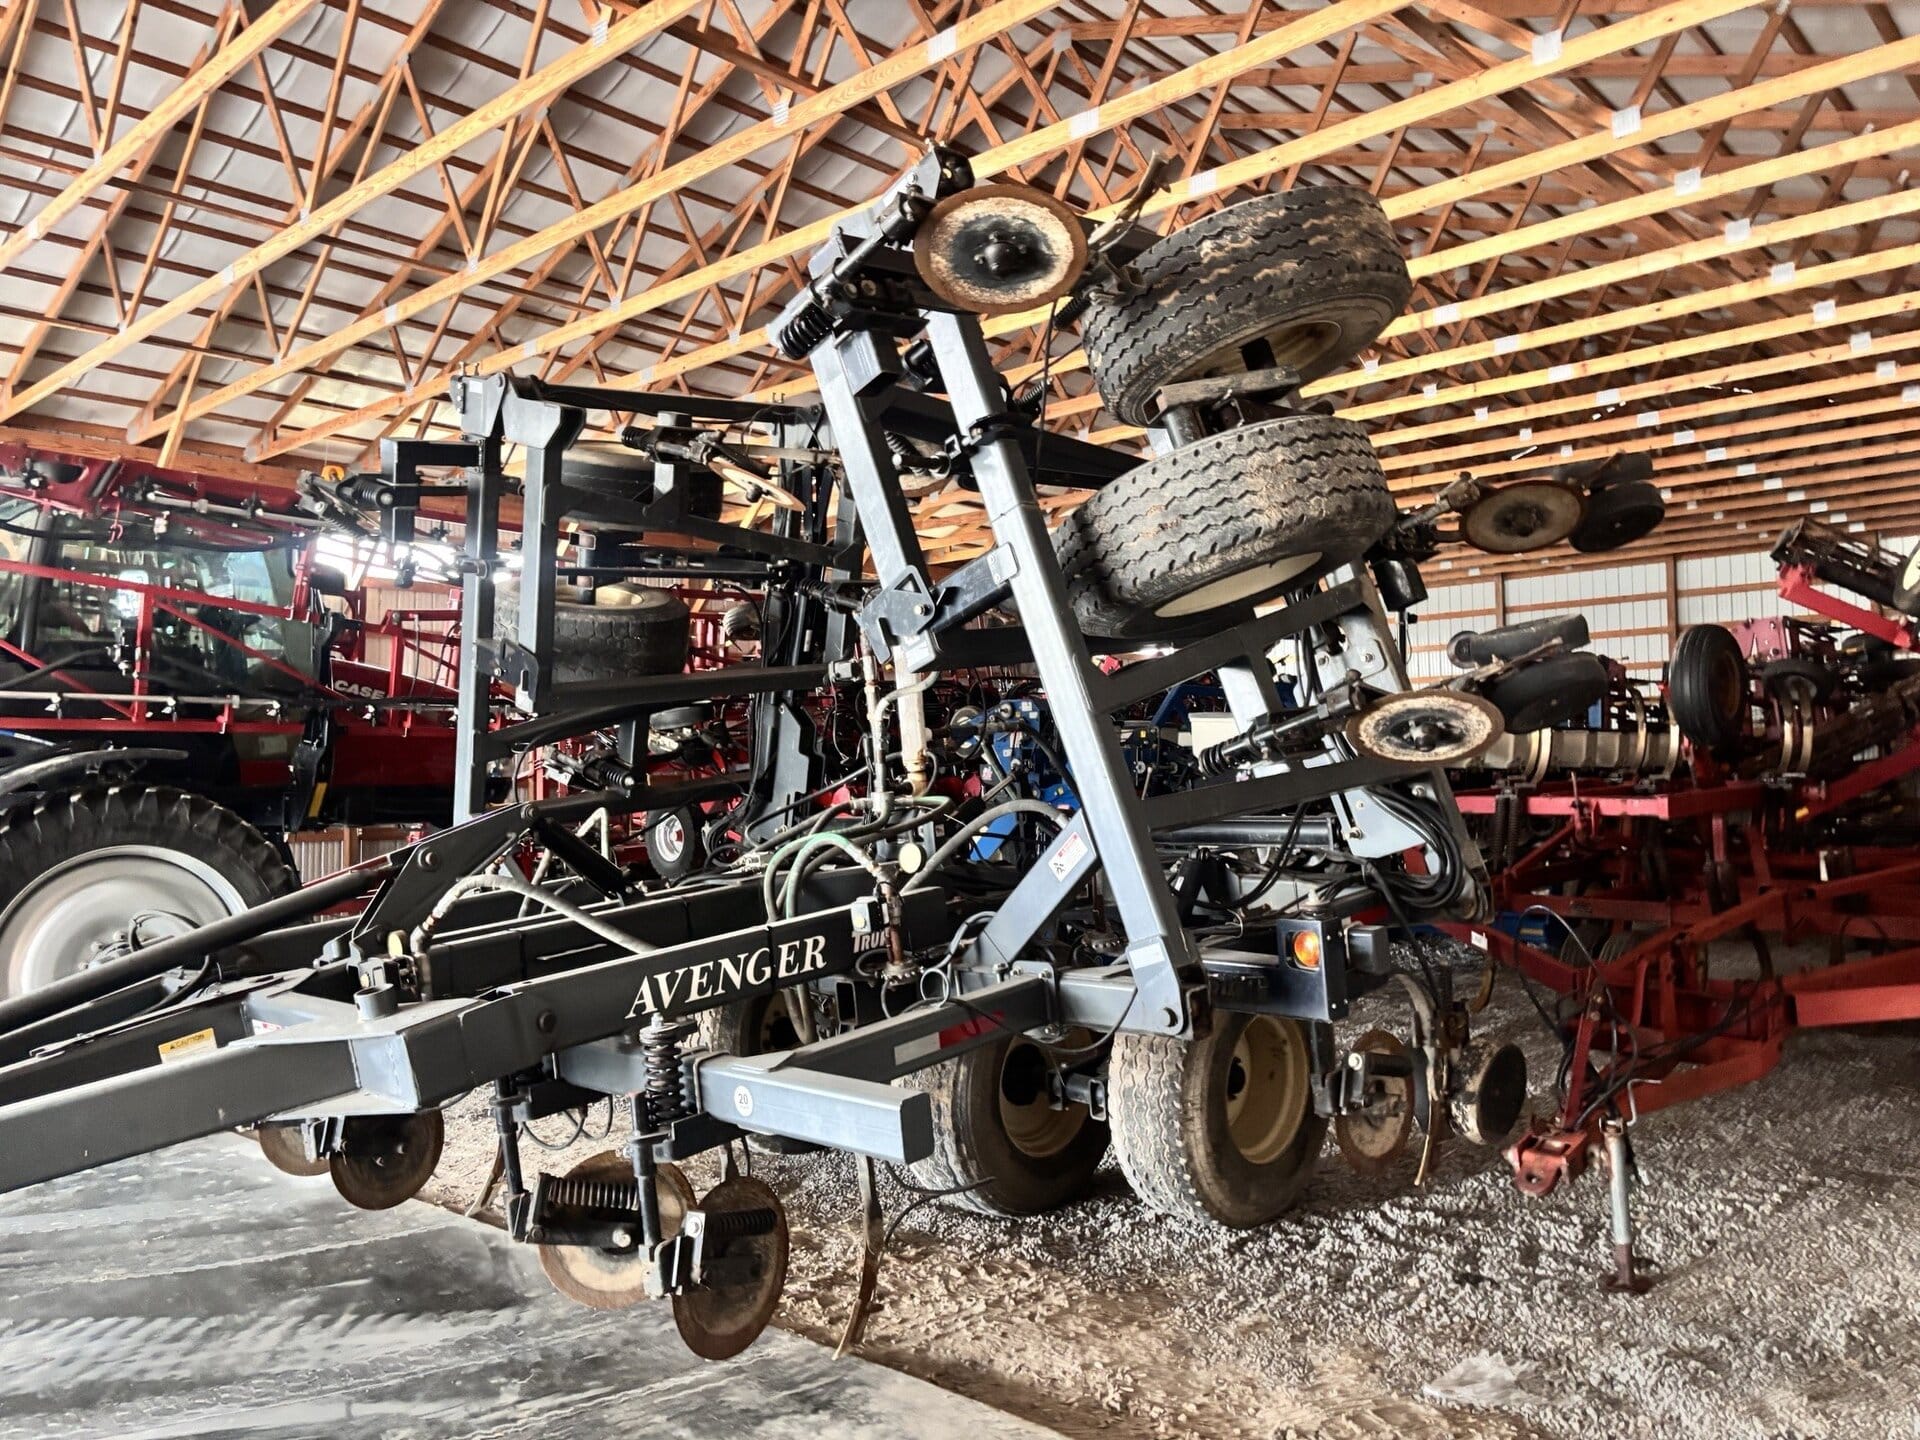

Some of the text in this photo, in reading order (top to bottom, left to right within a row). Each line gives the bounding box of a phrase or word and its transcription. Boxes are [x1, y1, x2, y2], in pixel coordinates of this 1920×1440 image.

[335, 680, 386, 700] CASE
[624, 935, 828, 1019] AVENGER
[738, 1093, 749, 1105] 20
